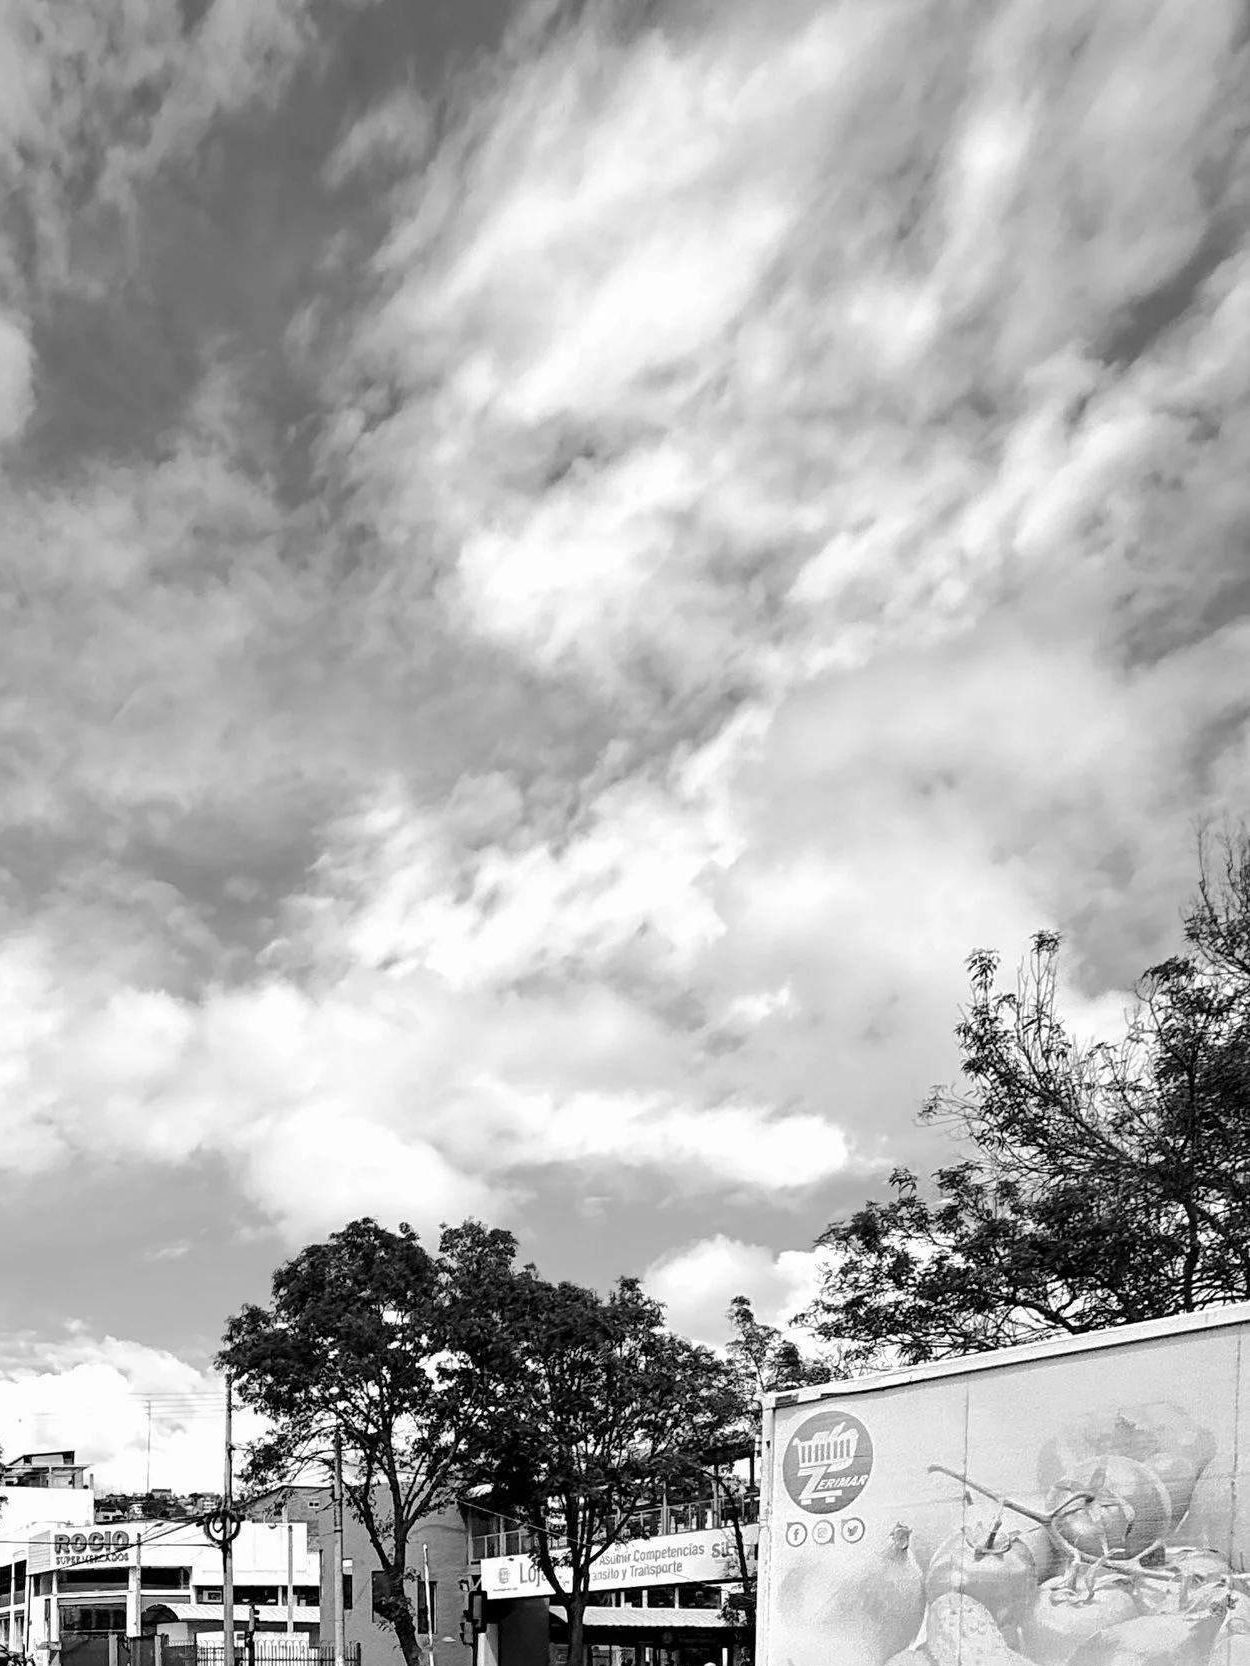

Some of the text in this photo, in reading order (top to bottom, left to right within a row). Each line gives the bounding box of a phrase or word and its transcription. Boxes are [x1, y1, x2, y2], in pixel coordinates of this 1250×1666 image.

[797, 1465, 870, 1501] ZERIMAR
[54, 1530, 130, 1555] ROCIO
[591, 1559, 683, 1582] ansito y Transporte
